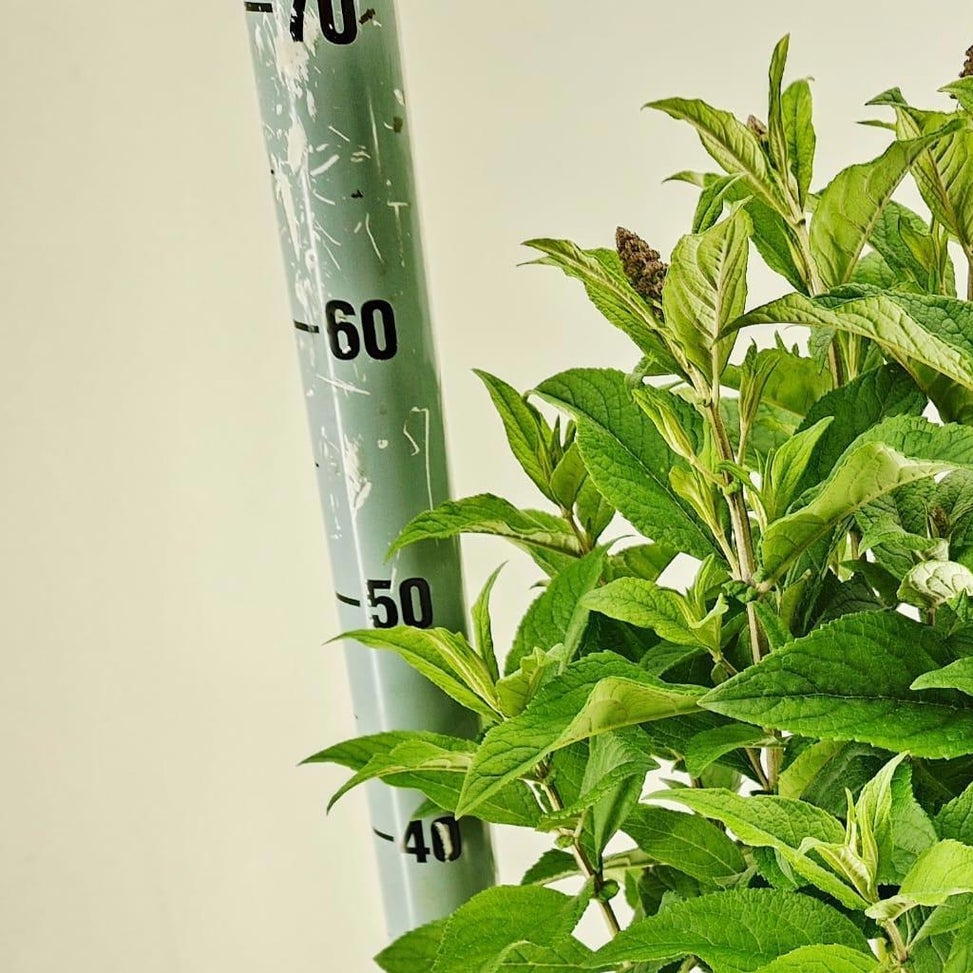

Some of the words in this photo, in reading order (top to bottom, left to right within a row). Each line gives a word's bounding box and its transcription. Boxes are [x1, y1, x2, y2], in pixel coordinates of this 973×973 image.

[326, 299, 397, 361] 60
[366, 577, 433, 630] 50
[404, 816, 462, 863] 40
